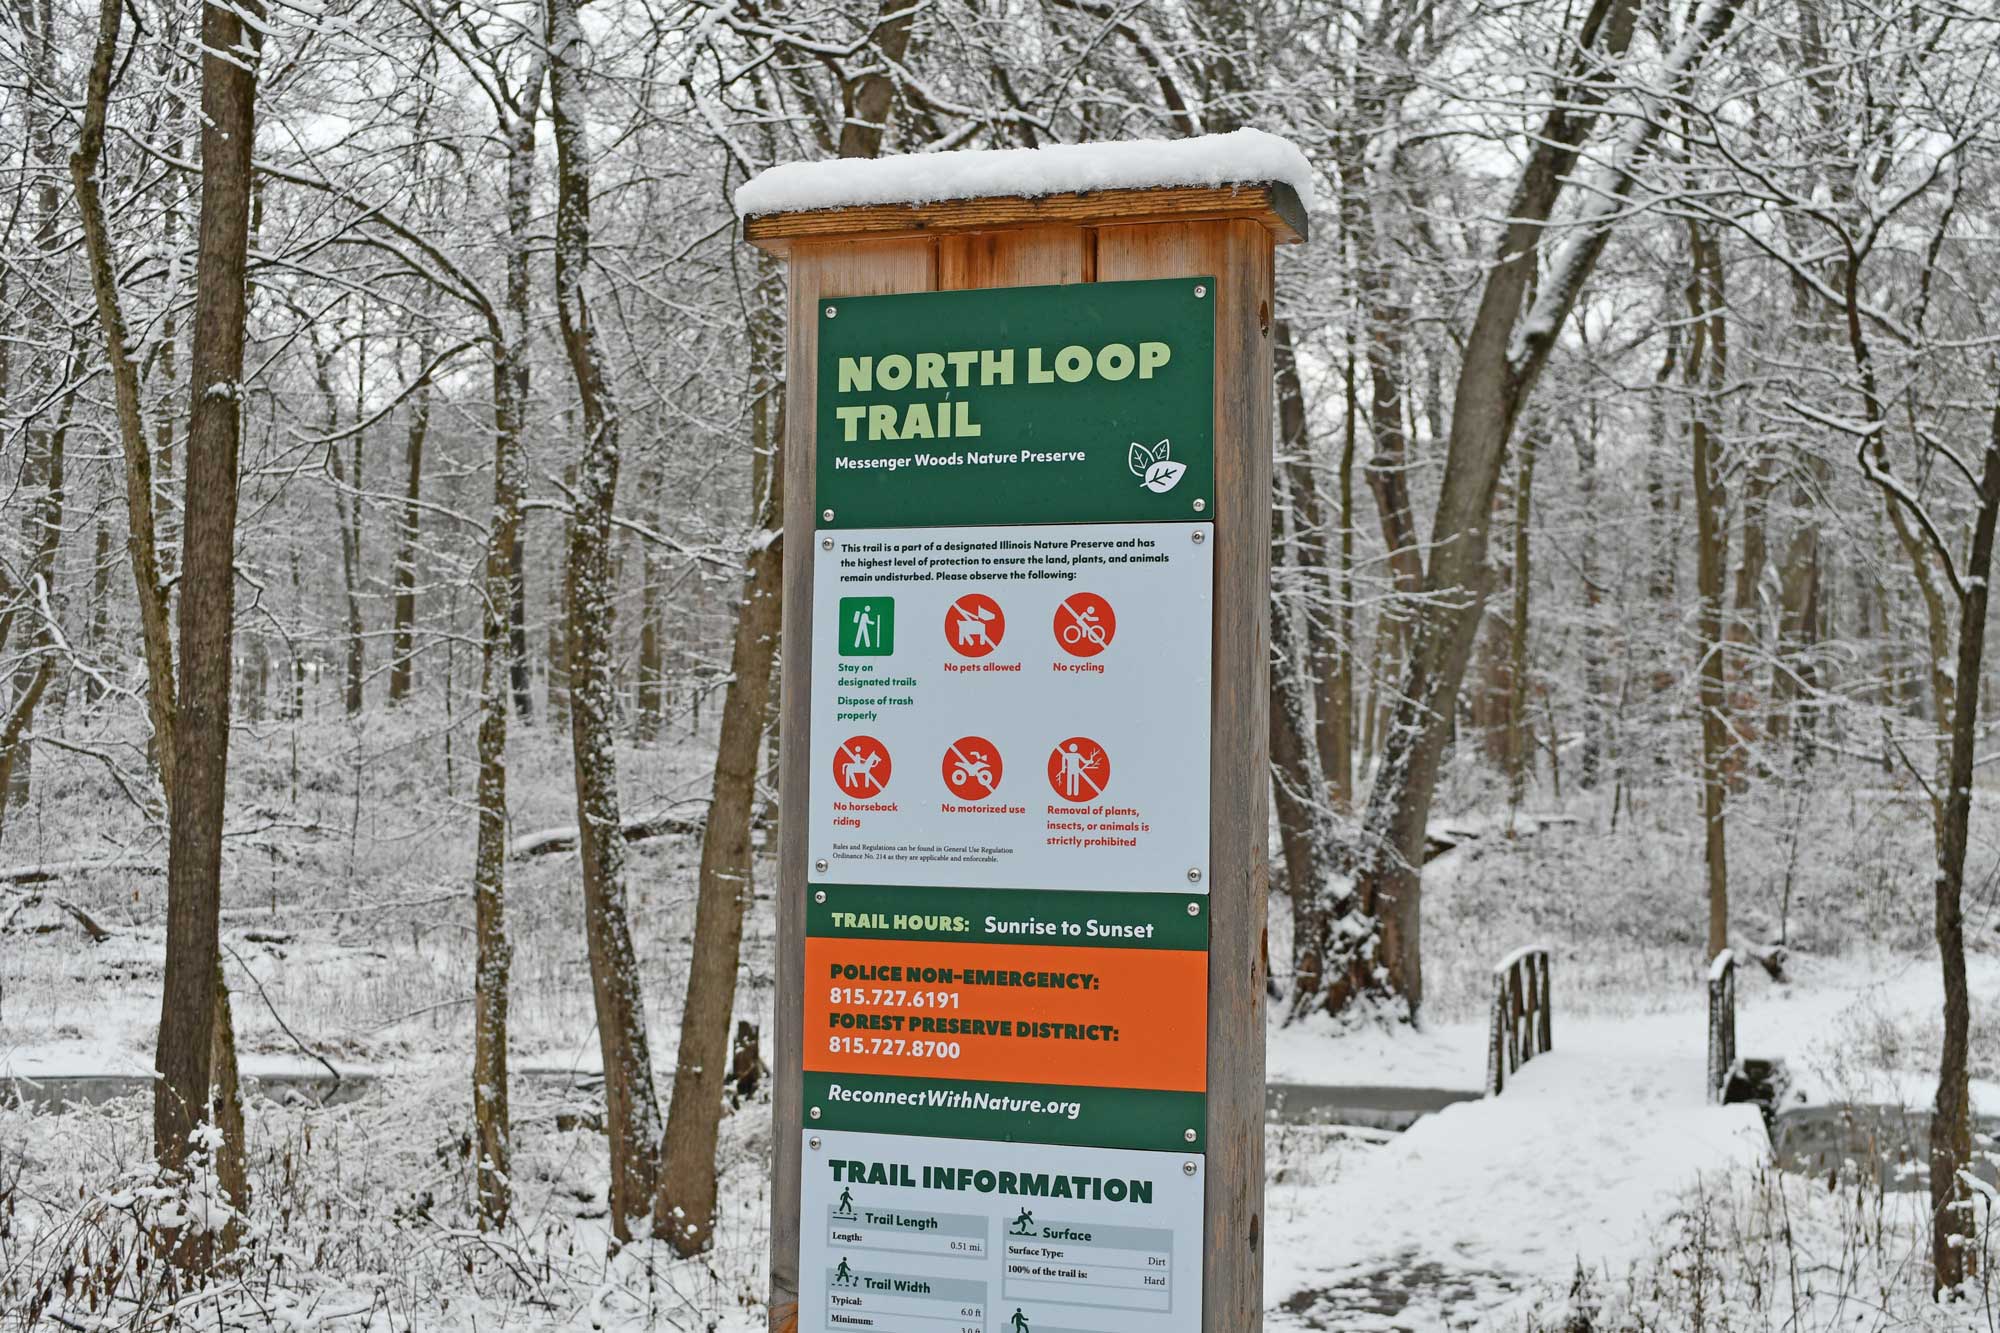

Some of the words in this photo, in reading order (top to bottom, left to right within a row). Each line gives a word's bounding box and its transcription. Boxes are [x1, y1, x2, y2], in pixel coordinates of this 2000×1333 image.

[838, 349, 1014, 393] NORTH
[1028, 342, 1171, 384] LOOP
[836, 401, 981, 442] TRAIL
[835, 457, 912, 470] Messenger
[914, 452, 964, 466] Woods
[967, 452, 1018, 465] Nature
[1021, 450, 1085, 463] Preserve
[841, 543, 861, 553] This
[862, 543, 882, 552] trail
[884, 543, 892, 552] is
[901, 543, 922, 554] part
[923, 541, 934, 551] of
[943, 540, 998, 553] designated
[999, 540, 1032, 550] Illinois
[1033, 540, 1068, 549] Nature
[1070, 539, 1114, 549] Preserve
[1116, 538, 1135, 548] and
[1137, 538, 1155, 547] has
[840, 558, 856, 567] the
[857, 558, 892, 569] highest
[894, 557, 916, 567] level
[917, 556, 928, 566] of
[929, 556, 980, 568] protection
[1027, 555, 1044, 564] the
[1045, 554, 1070, 565] land,
[1072, 554, 1106, 566] plants,
[1108, 553, 1128, 563] and
[1129, 553, 1169, 563] animals
[840, 573, 873, 582] remain
[874, 571, 934, 582] undisturbed.
[936, 571, 968, 581] Please
[969, 571, 1008, 580] observe
[1010, 570, 1026, 580] the
[1028, 570, 1077, 581] following:
[838, 663, 860, 674] Stay
[944, 663, 958, 672] No
[960, 664, 981, 674] pets
[982, 662, 1021, 672] allowed
[1053, 662, 1068, 672] No
[1069, 662, 1105, 674] cycling
[838, 677, 890, 689] designated
[892, 677, 917, 686] trails
[837, 696, 875, 707] Dispose
[876, 695, 887, 705] of
[888, 696, 914, 705] trash
[837, 710, 877, 722] properly
[833, 802, 848, 811] No
[849, 801, 898, 812] horseback
[941, 803, 956, 813] No
[957, 804, 1007, 814] motorized
[1047, 805, 1091, 815] Removal
[1092, 805, 1104, 815] of
[1105, 806, 1139, 818] plants,
[833, 816, 861, 828] riding
[1047, 820, 1085, 832] insects,
[1099, 821, 1139, 832] animals
[1141, 822, 1150, 832] is
[1046, 835, 1082, 848] strictly
[1084, 836, 1137, 848] prohibited
[862, 844, 896, 852] Regulations
[981, 846, 1014, 855] Regulation
[919, 854, 949, 863] applicable
[962, 855, 999, 863] enforceable.
[831, 912, 890, 929] TRAIL
[893, 914, 970, 932] HOURS:
[984, 916, 1057, 935] Sunrise
[1061, 921, 1081, 936] to
[1086, 919, 1154, 938] Sunset
[830, 963, 902, 982] POLICE
[906, 967, 1099, 990] NON-EMERGENCY:
[830, 987, 959, 1009] 815.727.6191
[829, 1012, 905, 1031] FOREST
[909, 1016, 1012, 1037] PRESERVE
[1016, 1021, 1119, 1042] DISTRICT:
[829, 1036, 960, 1059] 815.727.8700
[828, 1084, 1081, 1120] ReconnectWithNature.org
[828, 1159, 916, 1188] TRAIL
[922, 1166, 1153, 1204] INFORMATION
[865, 1212, 894, 1225] Trail
[896, 1215, 938, 1231] Length
[832, 1231, 862, 1243] Length:
[1043, 1227, 1092, 1242] Surface
[950, 1241, 966, 1251] 0.51
[969, 1243, 982, 1252] mi.
[1008, 1246, 1040, 1256] Surface
[1041, 1248, 1064, 1259] Type:
[1148, 1256, 1166, 1266] Dirt
[1008, 1265, 1031, 1274] 100%
[1031, 1266, 1042, 1275] of
[1042, 1267, 1057, 1276] the
[1058, 1269, 1076, 1278] trail
[1078, 1270, 1088, 1279] is:
[864, 1277, 891, 1290] Trail
[893, 1280, 931, 1294] Width
[1144, 1276, 1165, 1286] Hard
[831, 1295, 862, 1306] Typical:
[961, 1308, 973, 1316] 6.0
[975, 1308, 981, 1317] ft
[831, 1314, 873, 1326] Minimum:
